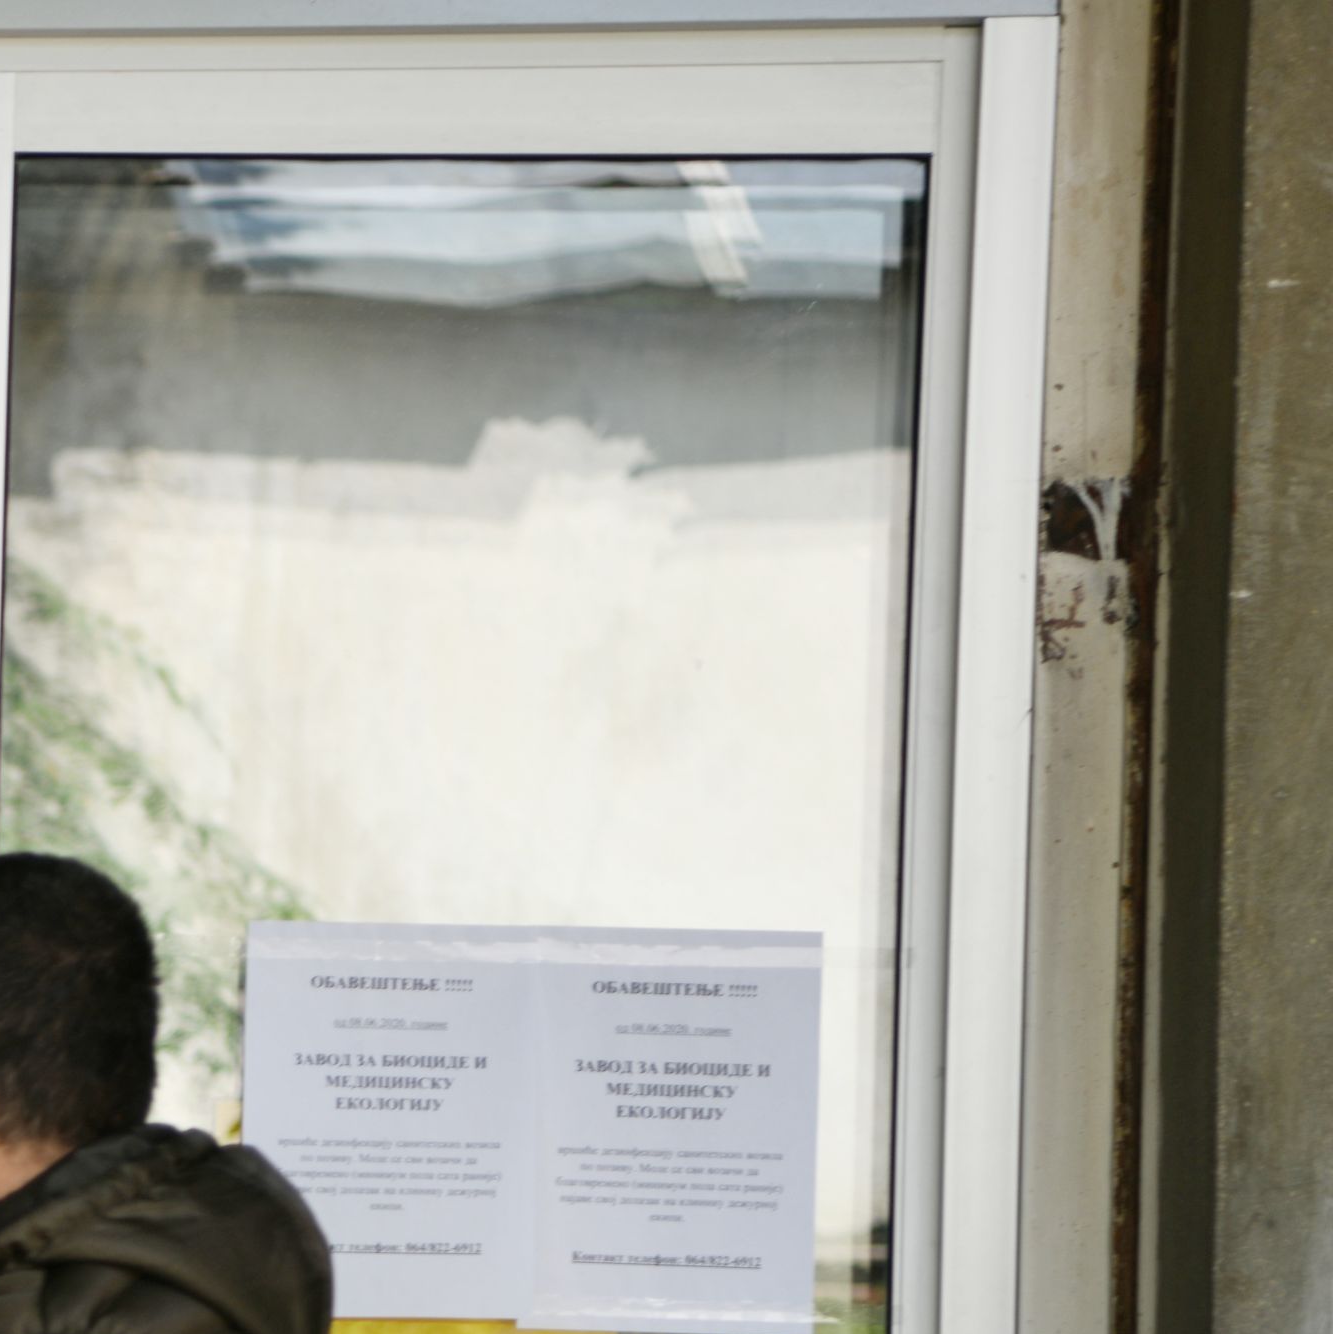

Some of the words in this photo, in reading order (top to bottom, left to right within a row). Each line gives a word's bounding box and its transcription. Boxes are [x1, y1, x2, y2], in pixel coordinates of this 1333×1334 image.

[310, 976, 440, 992] ОБАВЕШТЕЊЕ
[592, 980, 724, 997] ОБАВЕШТЕЊЕ
[293, 1053, 351, 1068] ЗАВОД
[356, 1054, 376, 1068] ЗА
[381, 1055, 469, 1071] БИОЦИДЕ
[474, 1056, 488, 1069] И
[574, 1059, 633, 1074] ЗАВОД
[638, 1060, 658, 1075] ЗА
[664, 1061, 753, 1077] БИОЦИДЕ
[757, 1063, 770, 1077] И
[325, 1075, 454, 1090] МЕДИЦИНСКУ
[606, 1082, 738, 1098] МЕДИЦИНСКУ
[335, 1097, 444, 1112] ЕКОЛОГИЈУ
[616, 1105, 727, 1121] ЕКОЛОГИЈУ
